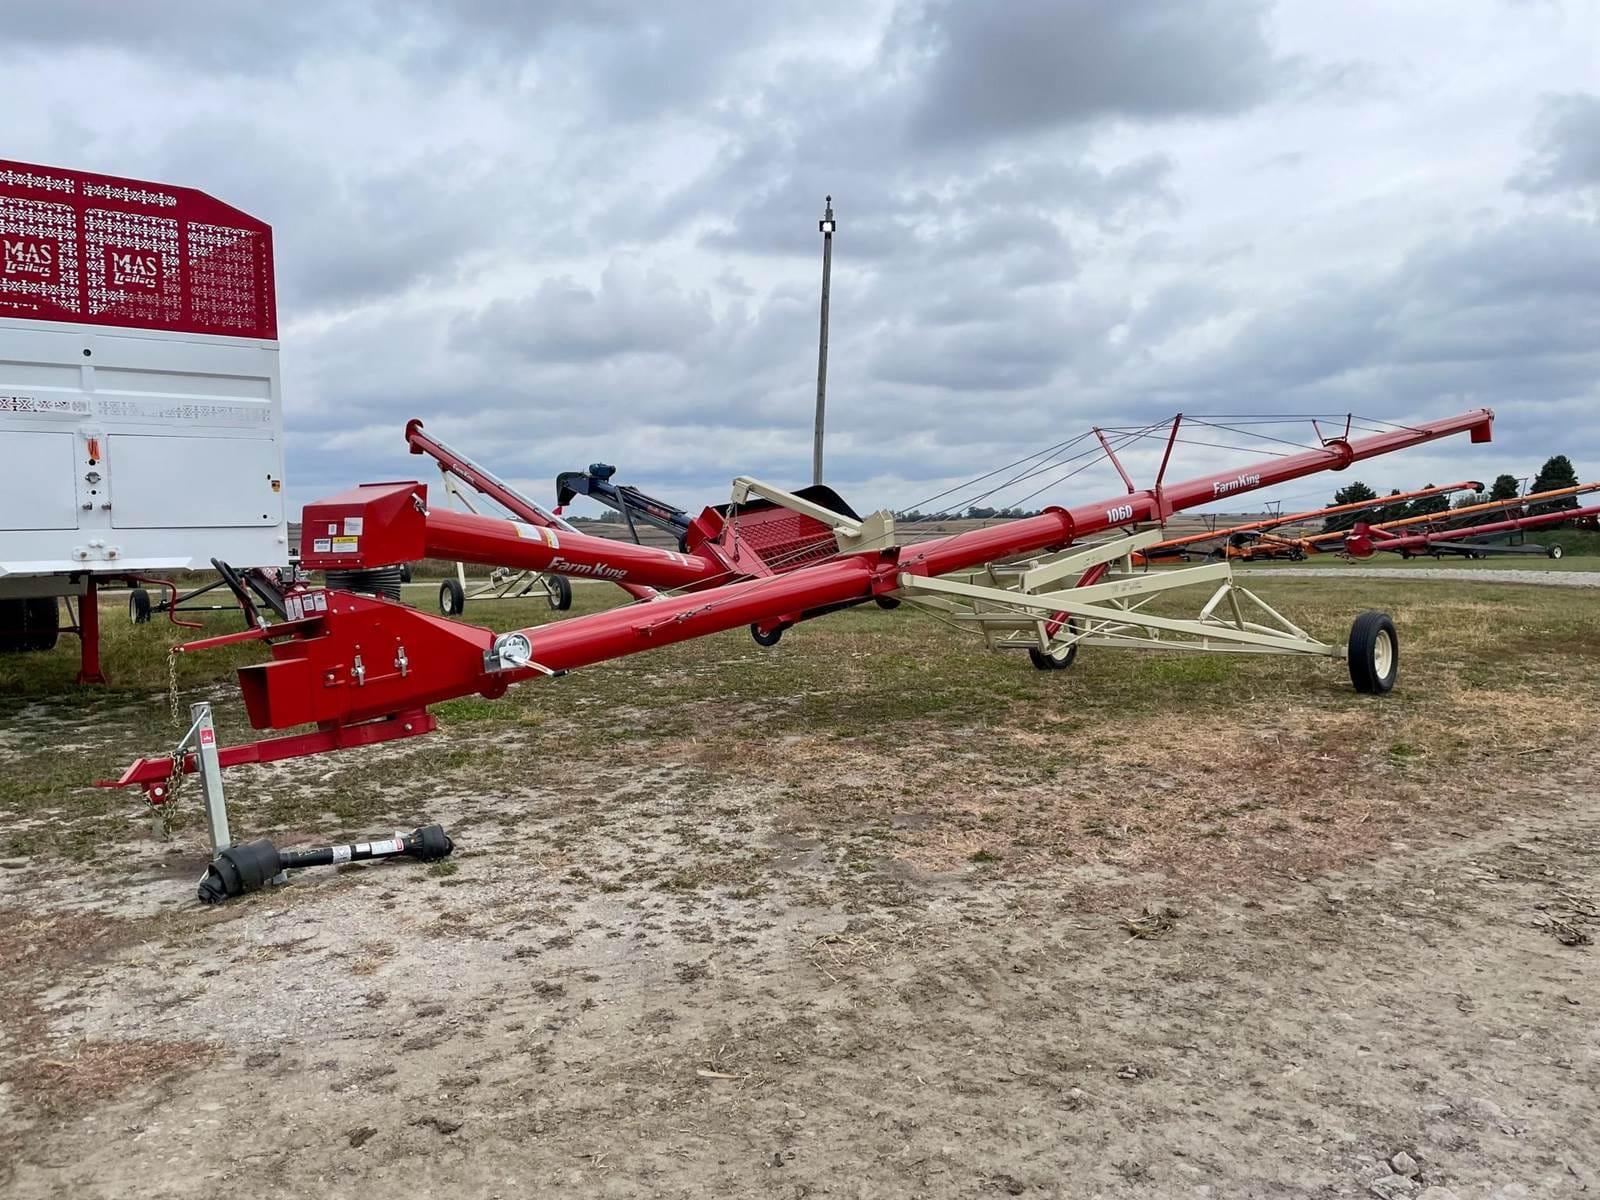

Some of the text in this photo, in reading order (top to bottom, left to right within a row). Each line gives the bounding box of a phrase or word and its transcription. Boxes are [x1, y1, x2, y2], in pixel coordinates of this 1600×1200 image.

[3, 240, 52, 264] MAS
[5, 261, 51, 276] Trailers
[112, 252, 157, 276] MAS
[114, 272, 156, 287] Trailers
[1108, 504, 1132, 523] 1060
[548, 557, 628, 578] Farm King
